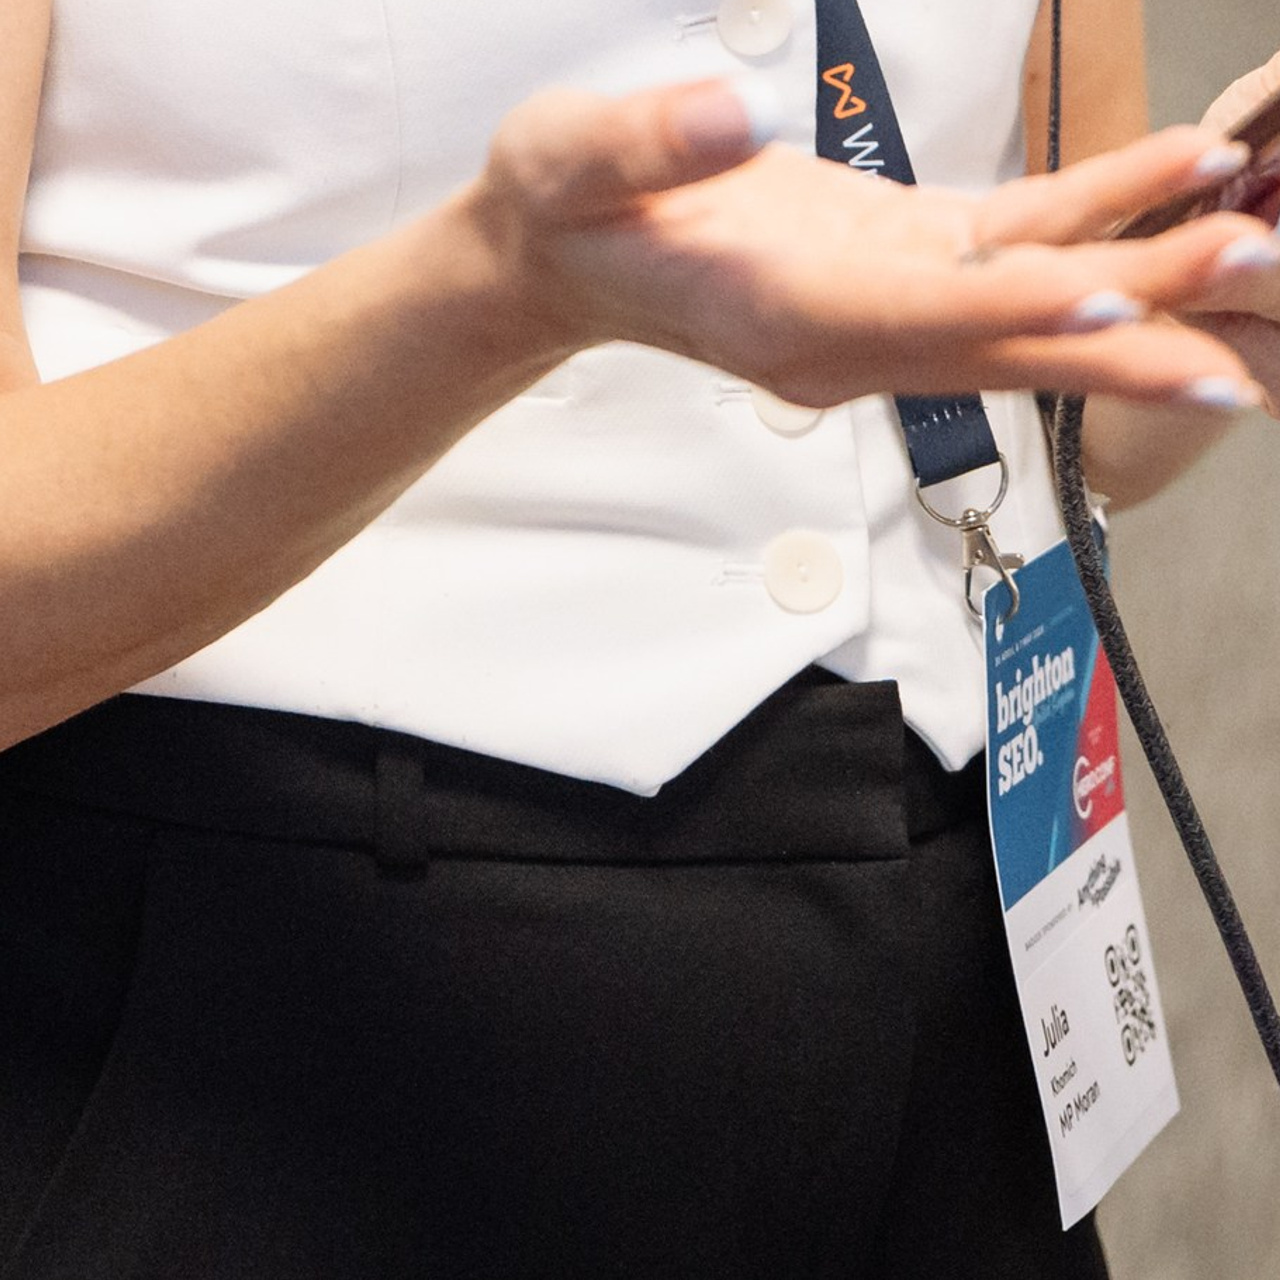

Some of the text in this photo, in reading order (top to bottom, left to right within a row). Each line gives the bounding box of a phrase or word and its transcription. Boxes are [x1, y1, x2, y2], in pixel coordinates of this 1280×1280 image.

[995, 646, 1075, 734] brighton
[1040, 1004, 1070, 1058] Julia
[1050, 1058, 1078, 1098] Khomich
[1059, 1081, 1100, 1138] MP Moran
